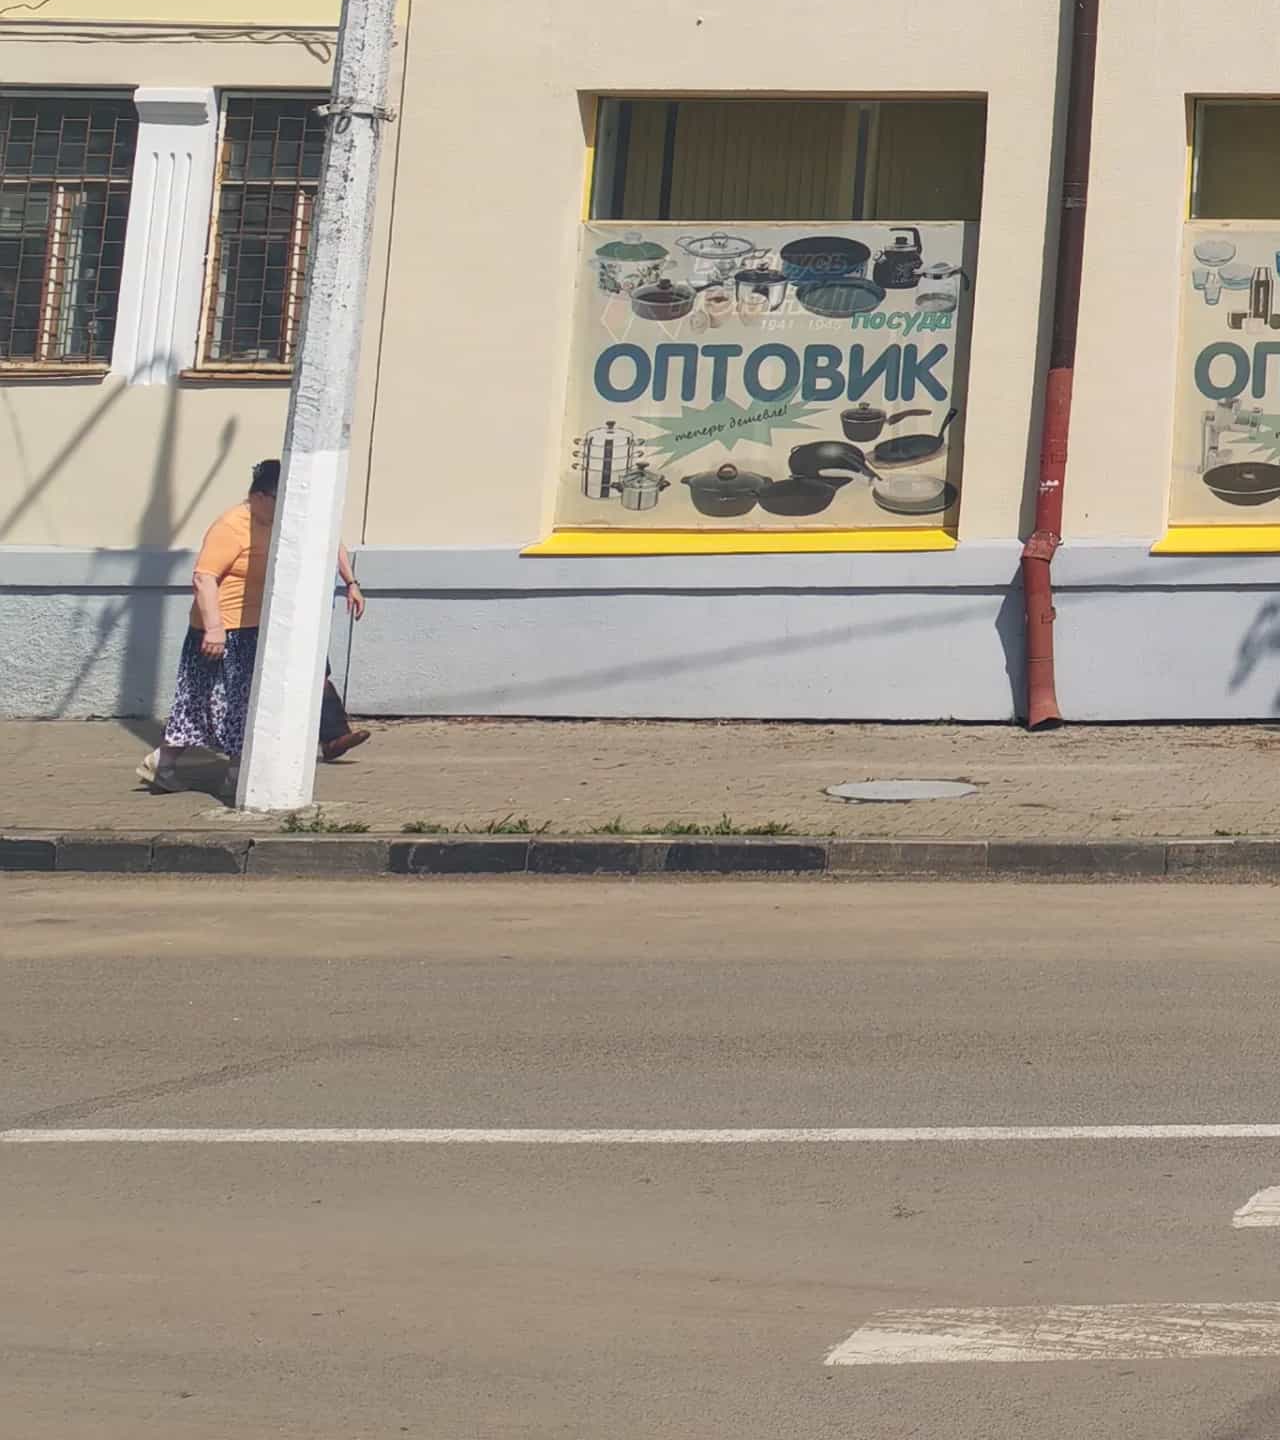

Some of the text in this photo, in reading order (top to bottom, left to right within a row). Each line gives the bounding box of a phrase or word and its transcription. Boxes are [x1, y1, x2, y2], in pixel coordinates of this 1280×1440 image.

[851, 311, 952, 336] посуда
[594, 342, 948, 403] ОПТОВИК
[674, 423, 727, 442] теперь
